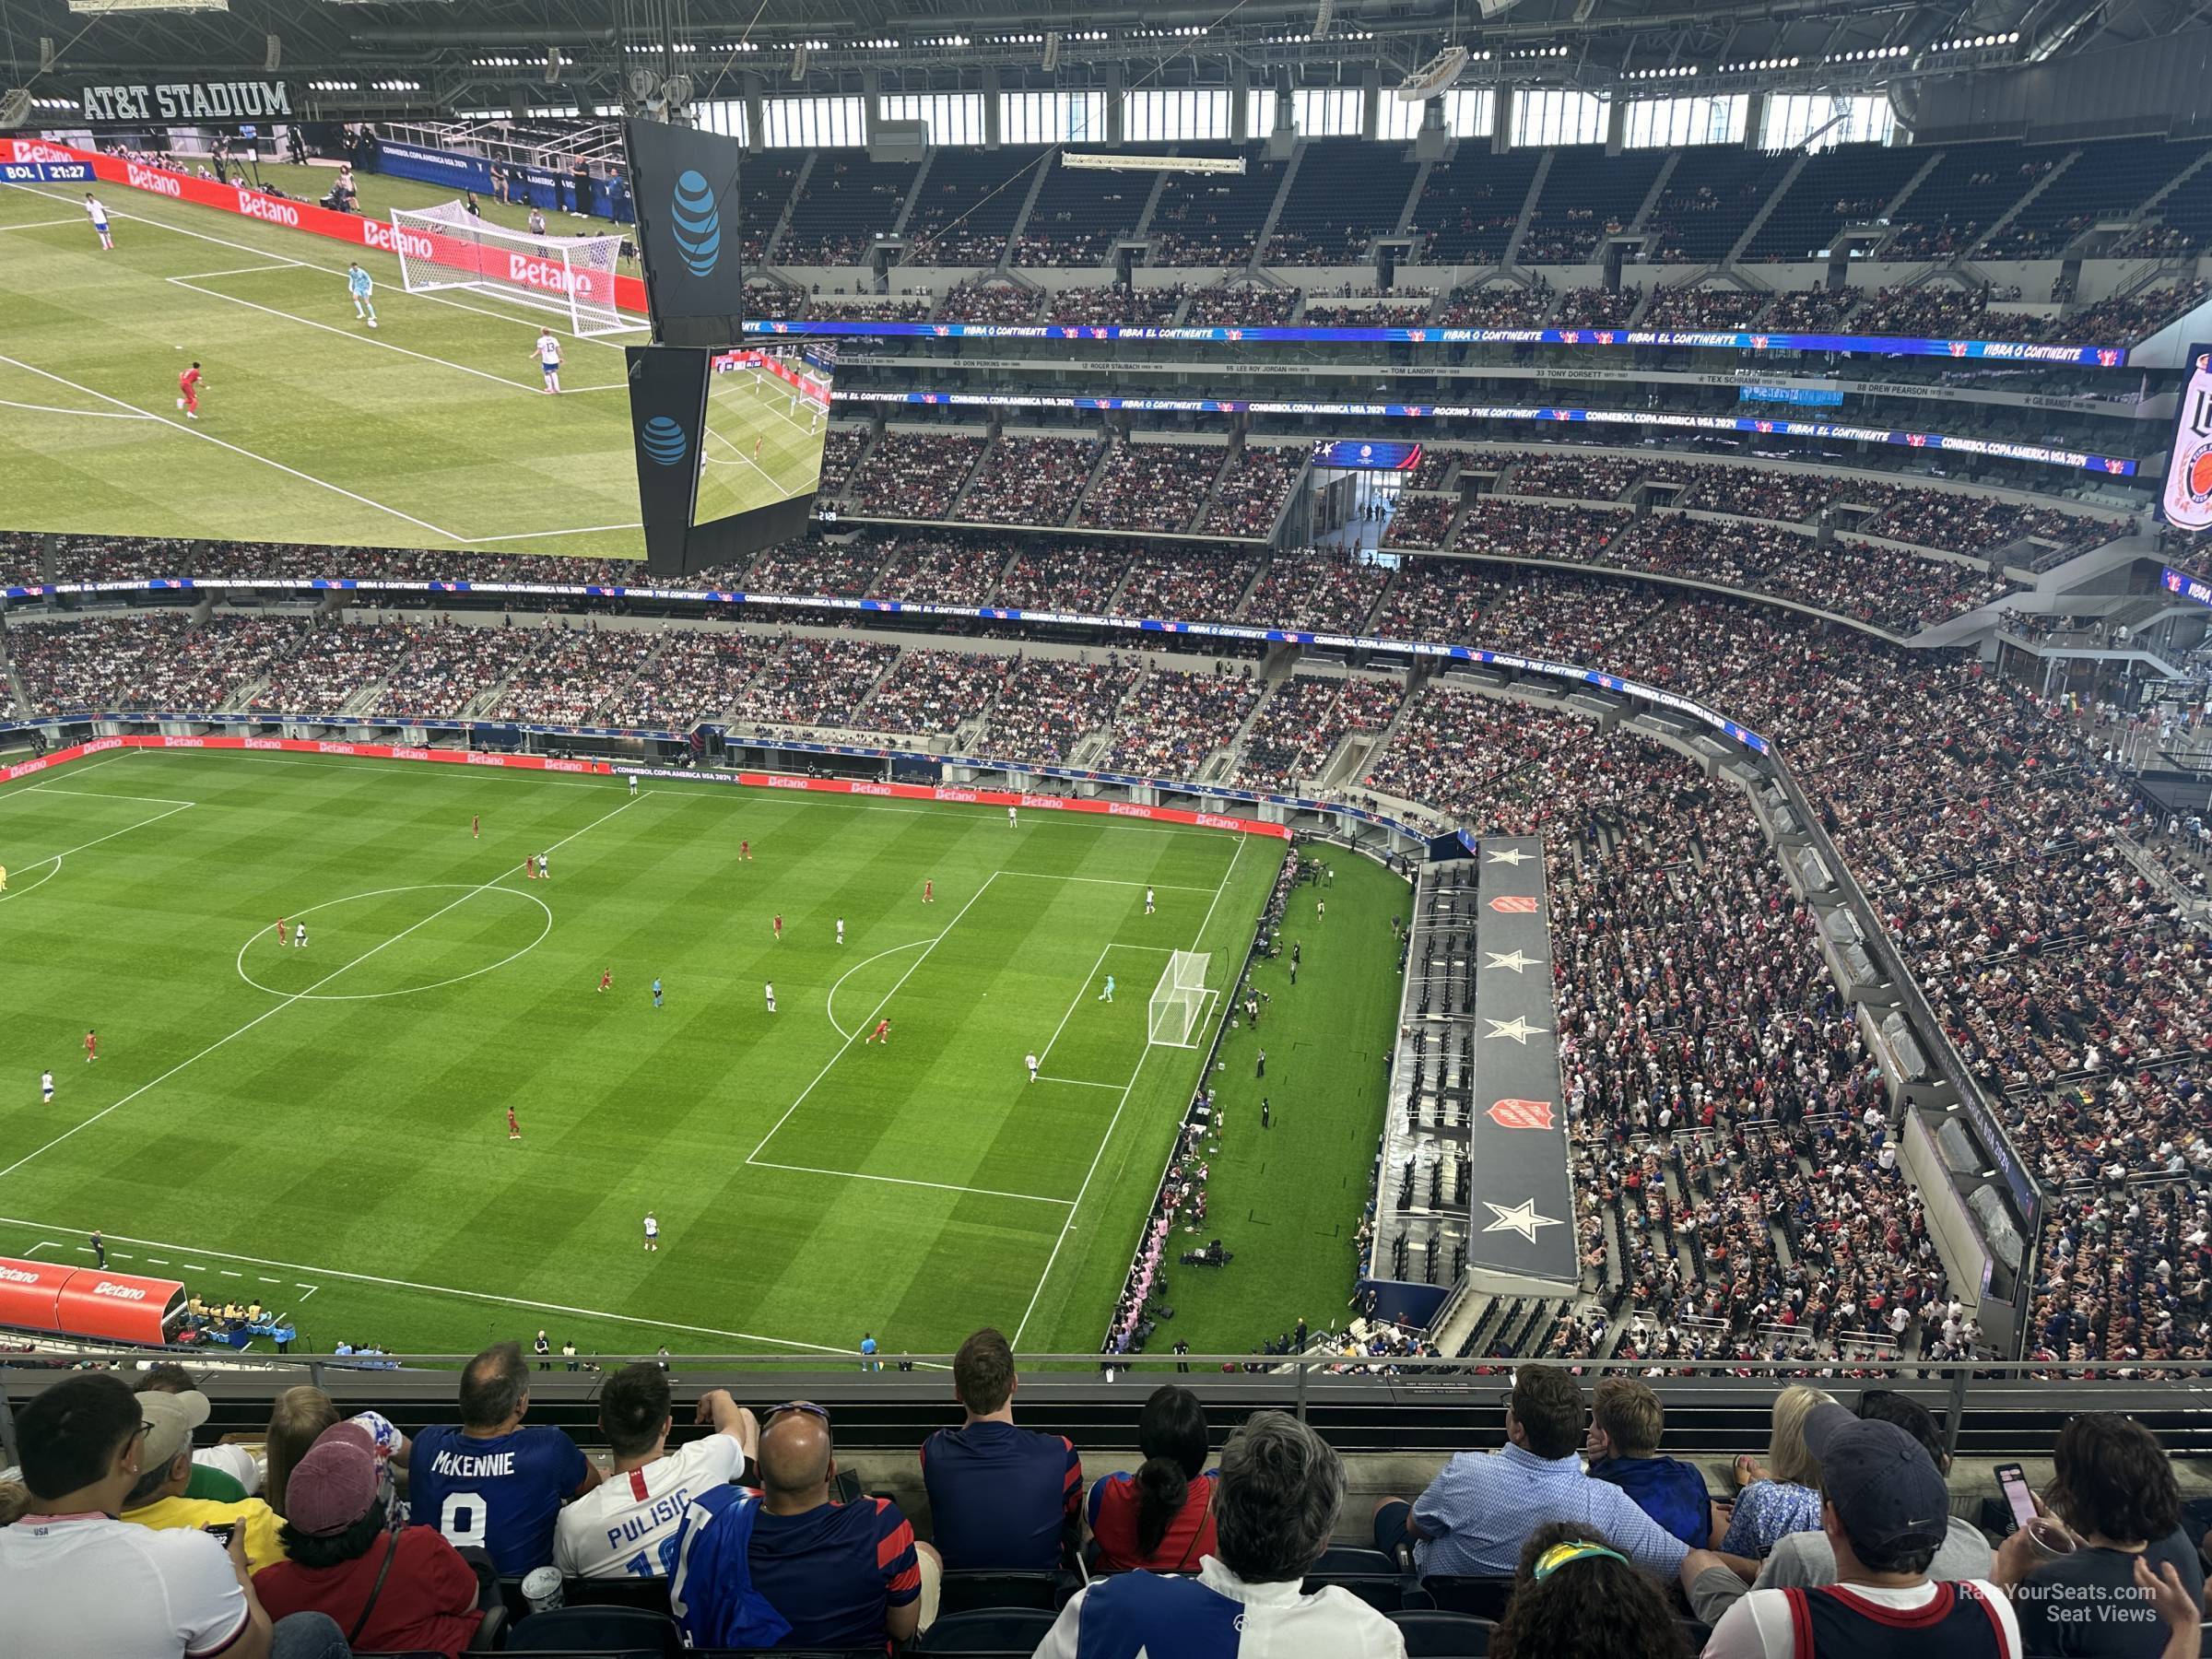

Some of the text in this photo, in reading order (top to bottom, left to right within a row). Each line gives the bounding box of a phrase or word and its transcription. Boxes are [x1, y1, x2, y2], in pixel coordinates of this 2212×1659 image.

[84, 82, 292, 120] AT&T STADIUM
[6, 165, 85, 180] BOL 21:27
[127, 163, 181, 196] Betano
[239, 190, 299, 226] Betano
[364, 221, 433, 258] Betano
[963, 326, 1048, 337] VIBRA O CONTINENTE
[1119, 328, 1213, 339] VIBRA EL CONTINENTE
[1443, 331, 1543, 342] VIBRA O CONTINENTE
[1628, 333, 1737, 346] VIBRA EL CONTINENTE
[546, 342, 555, 352] 13
[1983, 344, 2083, 361] VIBRA O CONTINENTE
[1707, 376, 1722, 384] TEX
[1724, 376, 1760, 386] SCHRAMM
[1856, 383, 1866, 392] 88
[1868, 383, 1889, 394] DREW
[1891, 385, 1928, 396] PEARSON
[860, 394, 908, 403] CONTINENTE
[1122, 400, 1143, 408] VIBRA
[1153, 401, 1202, 410] CONTINENTE
[1249, 403, 1292, 413] CONMEBOL
[1432, 408, 1540, 419] ROCKING THE CONTINENT
[1585, 411, 1634, 422] CONMEBOL
[1698, 418, 1713, 427] USA
[1715, 418, 1736, 429] 2024
[1787, 423, 1890, 442] VIBRA EL CONTINENTE
[1941, 437, 1986, 453] CONMEBOL
[2067, 453, 2087, 467] 2024
[56, 583, 81, 593] VIBRA
[97, 581, 150, 592] CONTINENTE
[2188, 582, 2211, 601] VIBRA
[624, 589, 653, 597] ROCKING
[670, 592, 709, 600] CONTINENT
[934, 606, 980, 616] CONTINENTE
[1219, 628, 1267, 639] CONTINENTE
[1493, 654, 1524, 666] ROCKING
[1544, 662, 1588, 679] CONTINENT
[84, 737, 123, 755] Betano
[165, 736, 204, 747] Betano
[245, 738, 281, 749] Betano
[320, 742, 354, 754] Betano
[393, 747, 428, 759] Betano
[467, 753, 504, 766] Betano
[10, 759, 47, 779] Betano
[545, 759, 582, 771] Betano
[618, 766, 732, 782] CONMEBOL COPA AMERICA USA 2024
[769, 776, 807, 789] Betano
[852, 782, 891, 796] Betano
[935, 789, 976, 802] Betano
[1022, 796, 1063, 809] Betano
[1109, 802, 1151, 818] Betano
[1195, 814, 1239, 829] Betano
[94, 1281, 147, 1300] Betano
[431, 1450, 515, 1477] McKENNIE
[606, 1488, 691, 1550] PULISIC
[34, 1527, 49, 1536] USA
